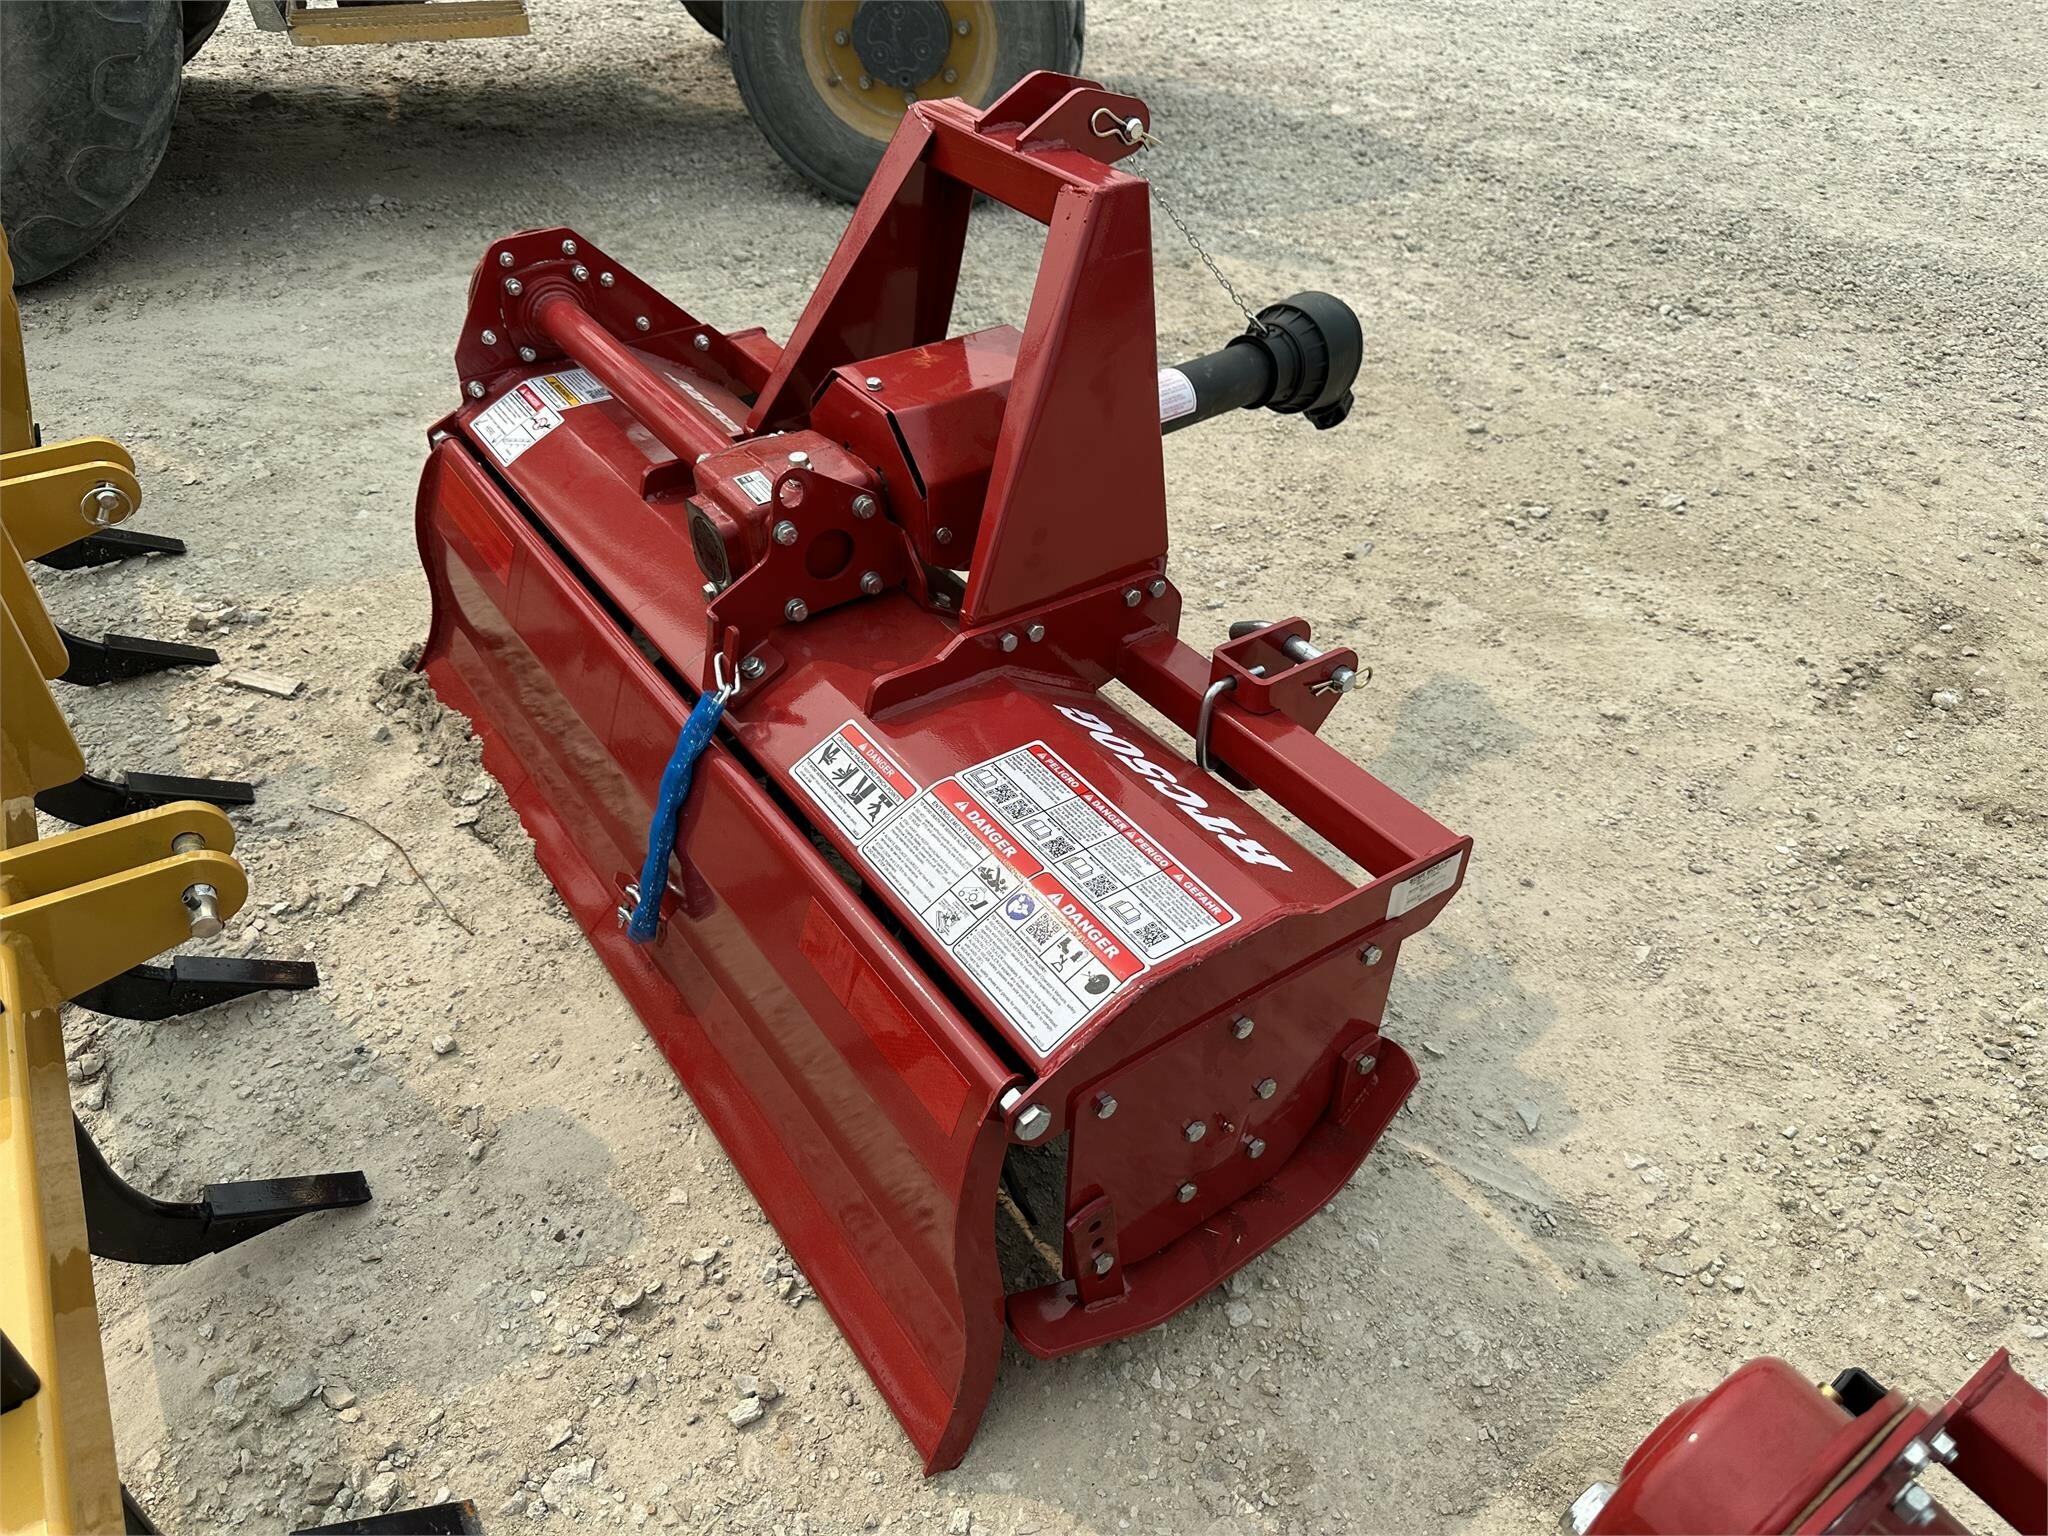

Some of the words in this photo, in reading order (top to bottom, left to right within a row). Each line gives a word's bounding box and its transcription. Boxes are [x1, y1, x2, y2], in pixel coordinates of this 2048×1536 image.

[835, 736, 855, 755] CRUSHING
[853, 753, 869, 769] HAZARD
[867, 768, 877, 777] AND
[874, 775, 887, 788] PINCH
[885, 786, 901, 802] POINTS
[864, 748, 895, 777] DANGER
[1044, 758, 1080, 788] PELIGRO
[1053, 704, 1293, 872] RTC50G
[931, 800, 965, 834] ENTANGLEMENT
[962, 831, 982, 851] HAZARD
[966, 809, 1016, 858] DANGER
[1090, 800, 1126, 829] DANGER
[1133, 838, 1169, 867] PERIGO
[1181, 881, 1222, 915] GEFAHR
[1060, 902, 1121, 959] DANGER
